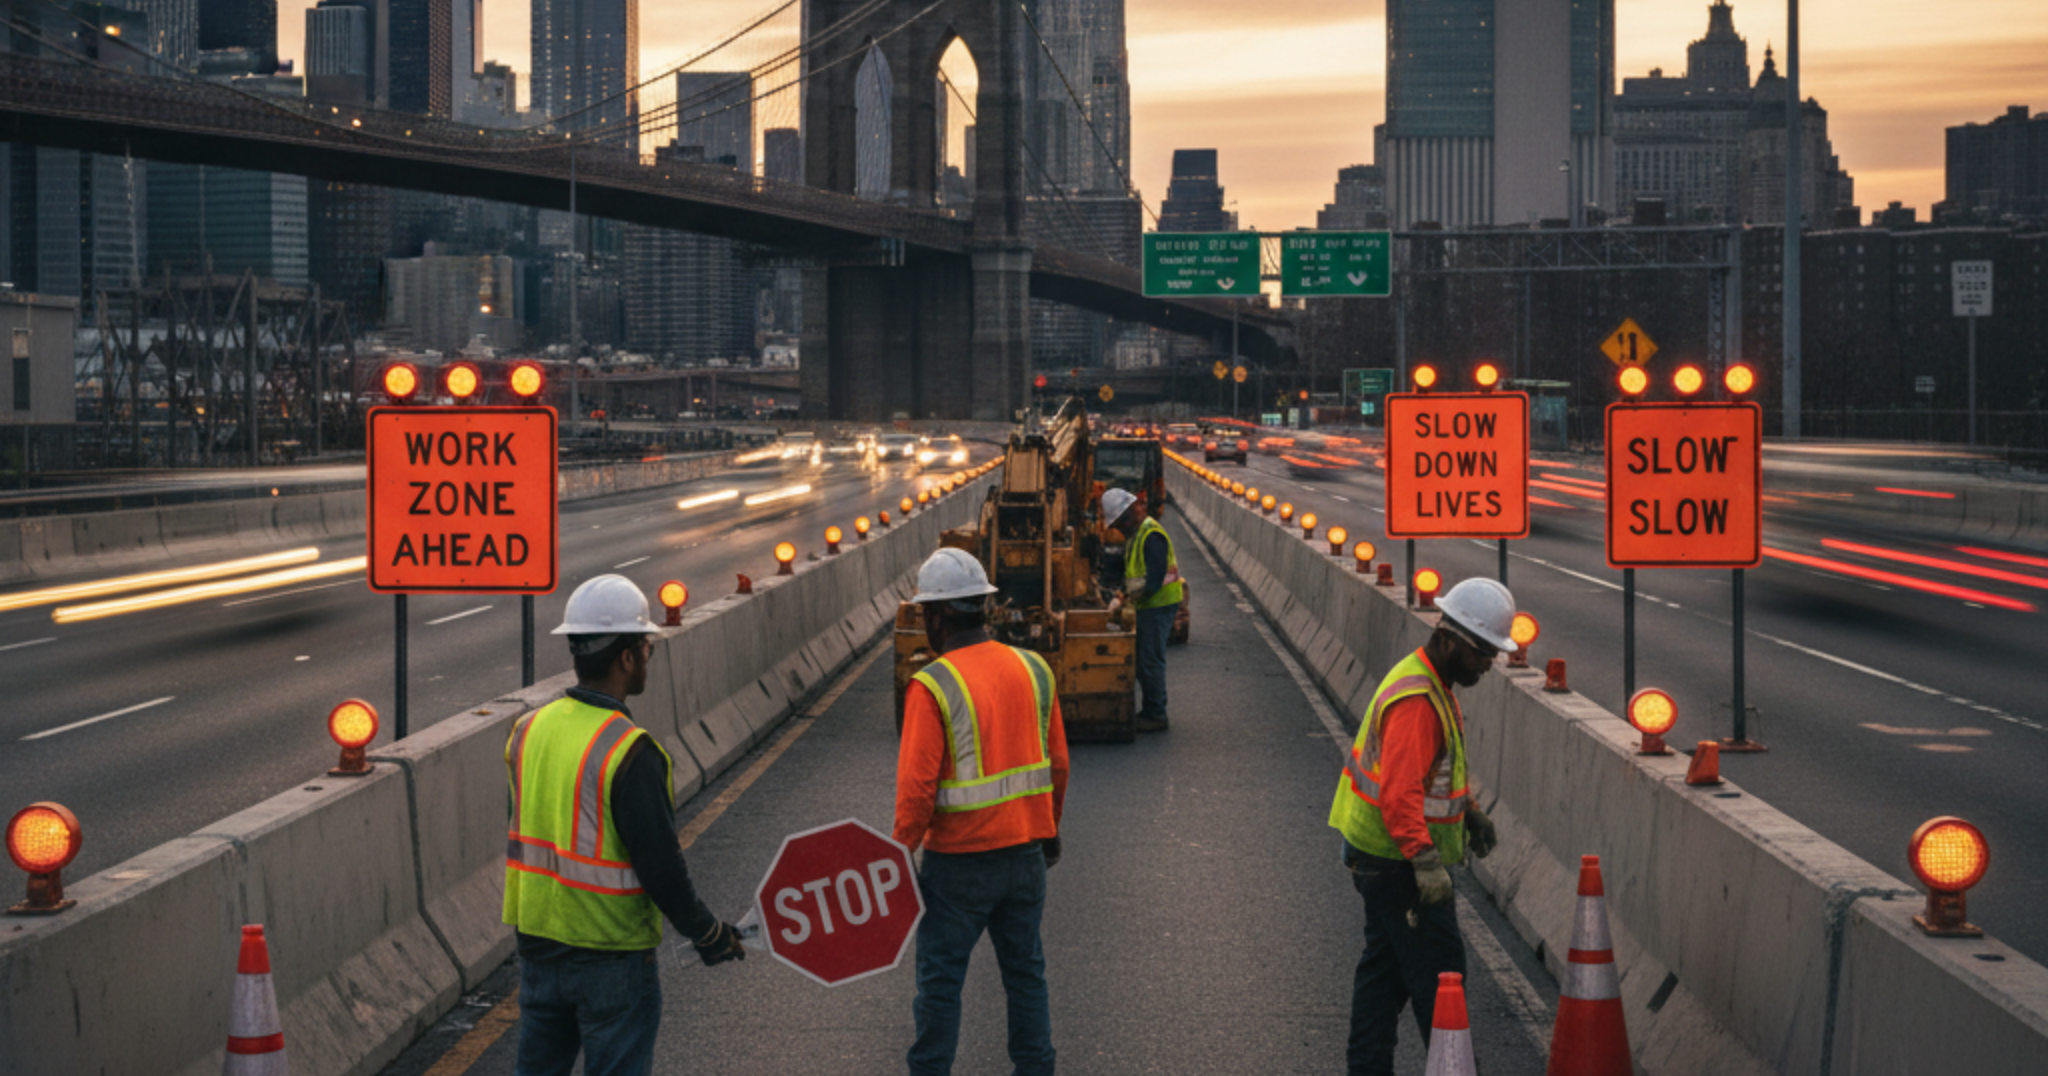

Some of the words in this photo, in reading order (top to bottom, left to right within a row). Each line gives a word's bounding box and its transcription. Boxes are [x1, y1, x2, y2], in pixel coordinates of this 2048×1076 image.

[1415, 412, 1497, 438] SLOW
[404, 431, 516, 466] WORK
[1415, 451, 1497, 478] DOWN
[409, 481, 515, 516] ZONE
[1417, 490, 1502, 518] LIVES
[1629, 498, 1729, 536] SLOW
[391, 533, 529, 567] AHEAD
[774, 858, 901, 945] STOP
